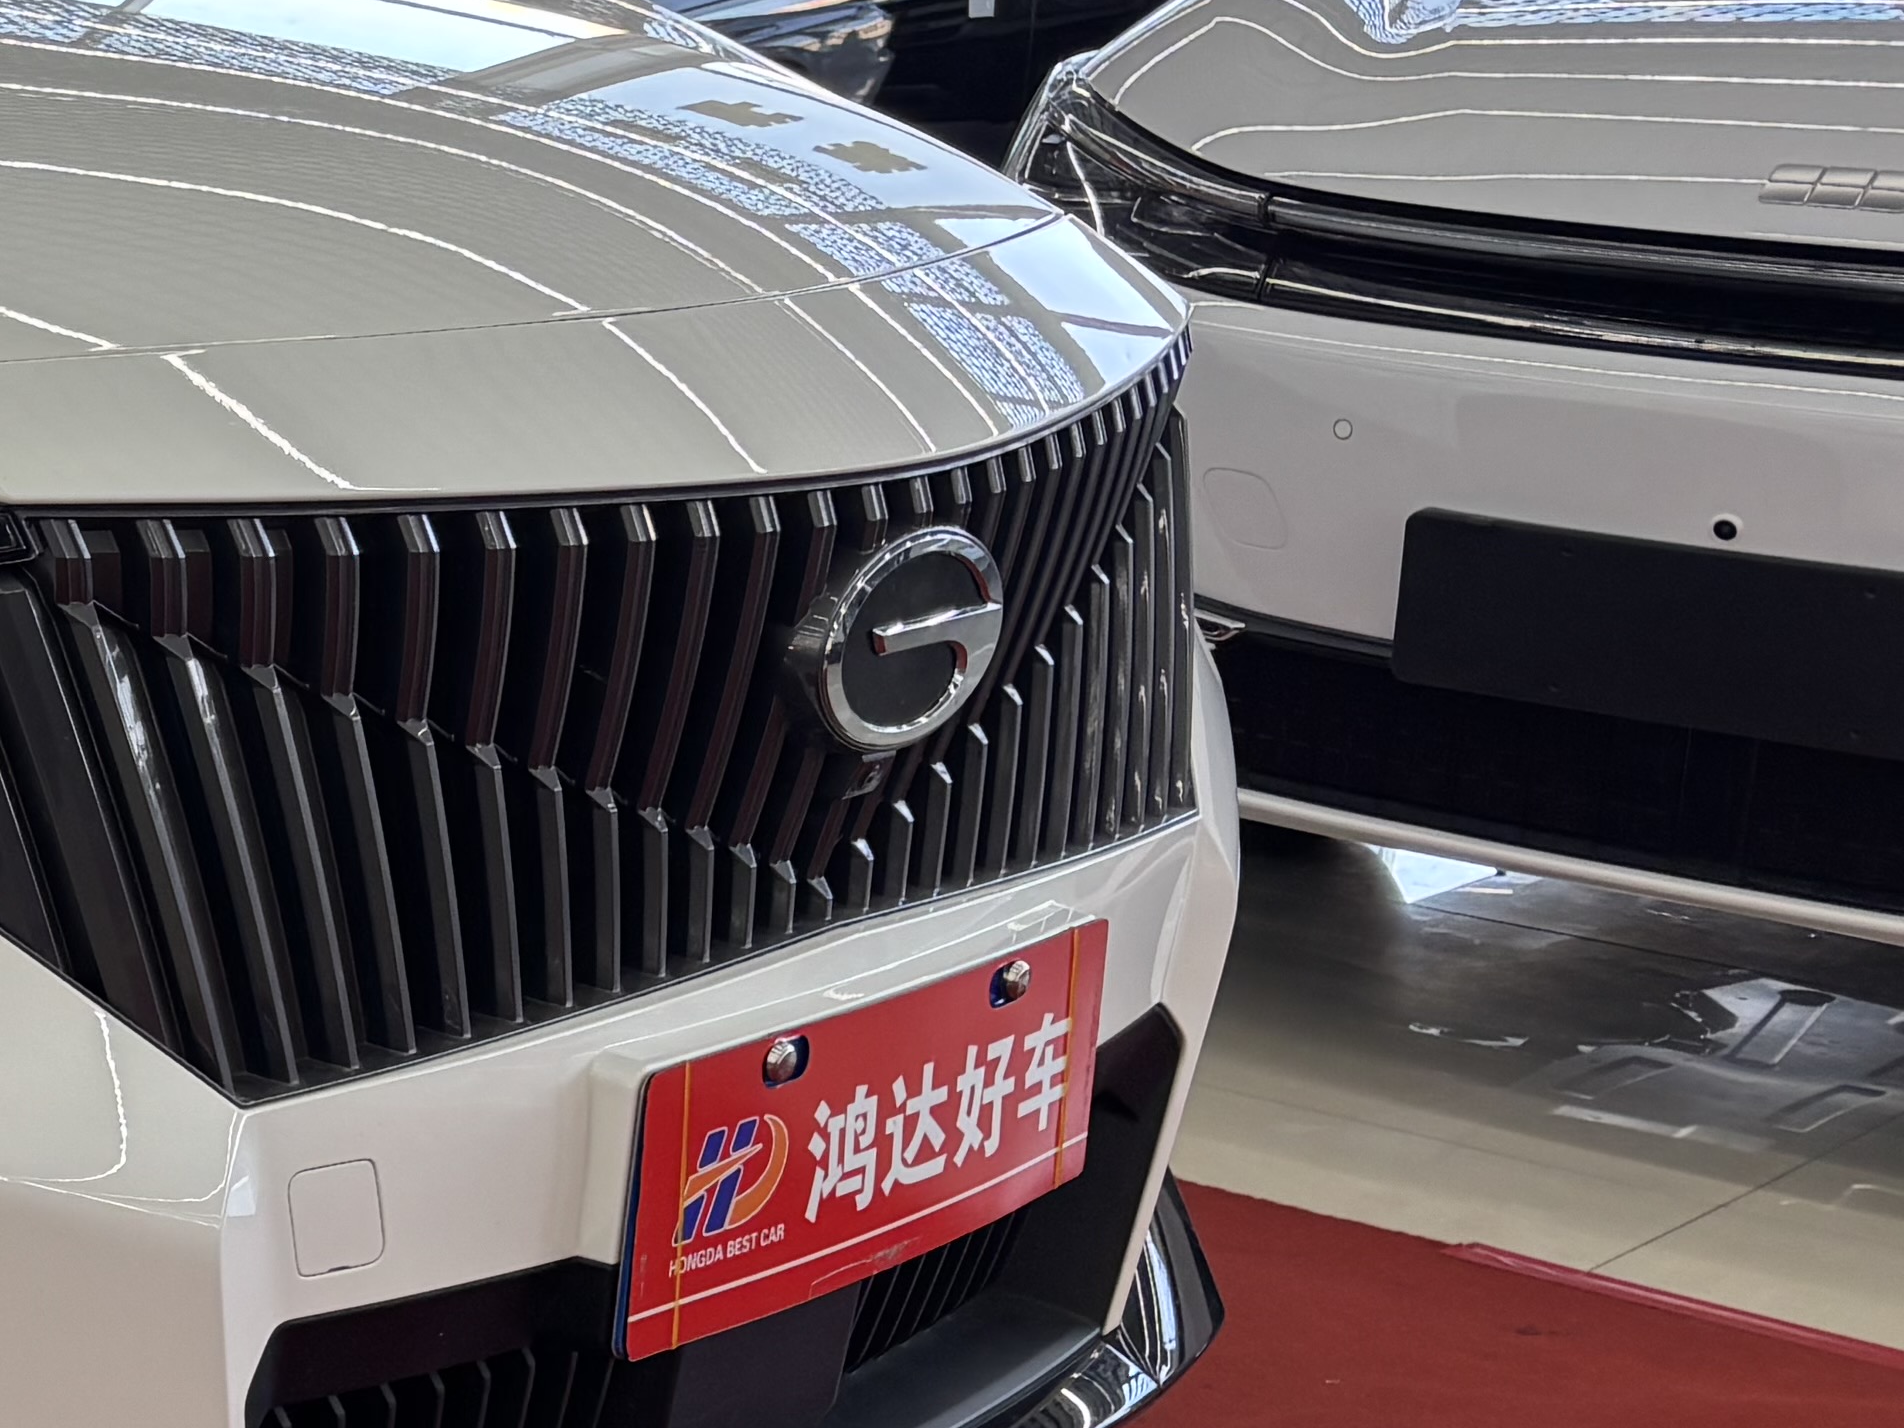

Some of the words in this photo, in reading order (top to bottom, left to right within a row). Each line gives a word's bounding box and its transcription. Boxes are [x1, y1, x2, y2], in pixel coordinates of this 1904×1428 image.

[804, 1011, 1072, 1225] 鸿达好车
[669, 1244, 723, 1277] HONGDA
[726, 1234, 758, 1258] BEST
[760, 1223, 785, 1247] CAR
